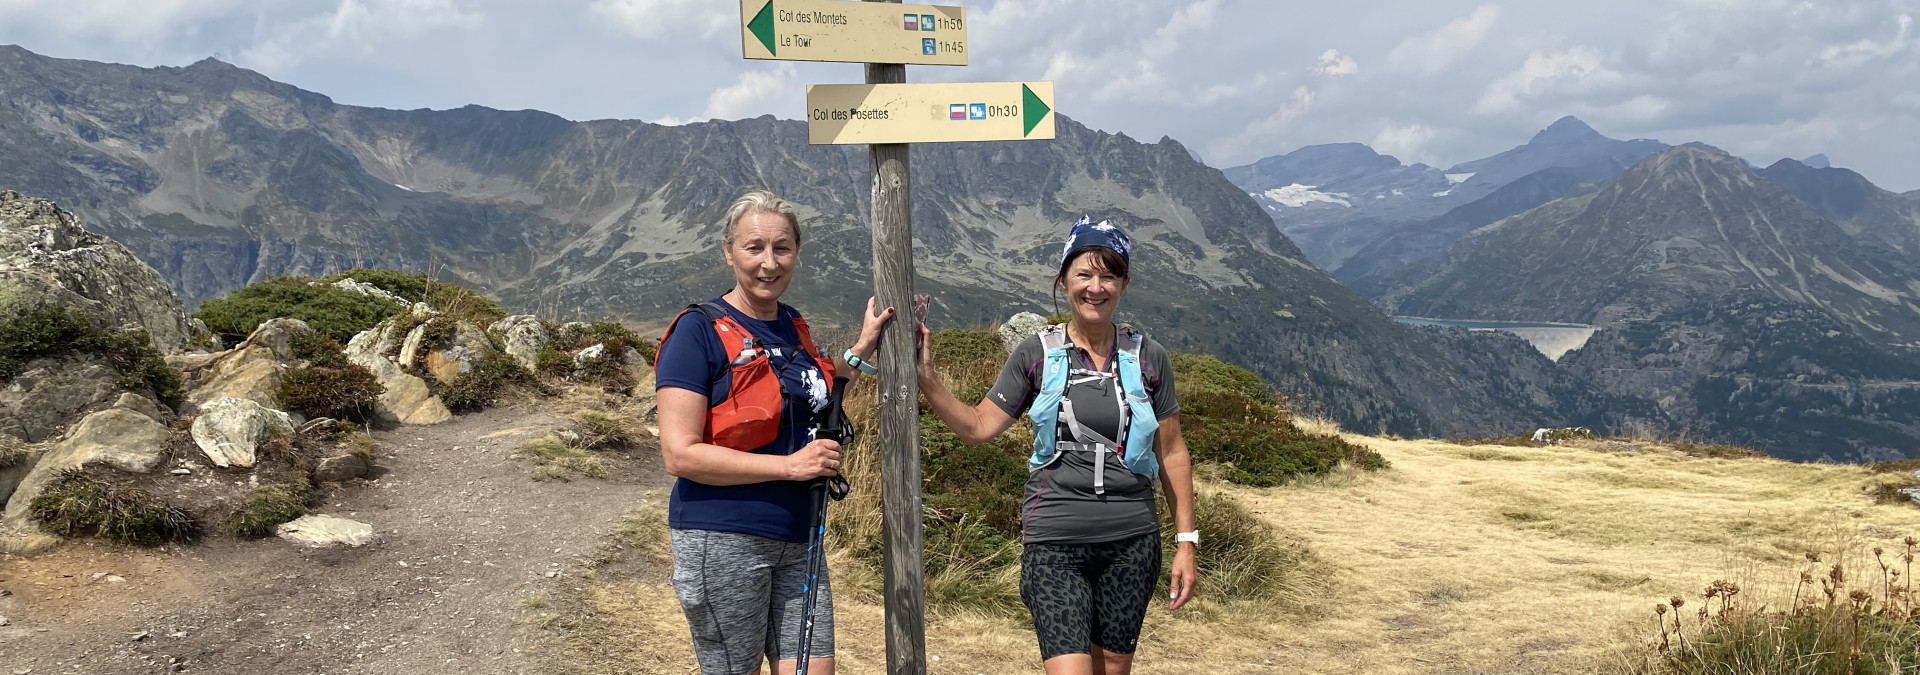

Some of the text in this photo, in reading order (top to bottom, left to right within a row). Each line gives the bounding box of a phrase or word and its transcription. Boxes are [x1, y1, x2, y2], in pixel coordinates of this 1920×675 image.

[779, 9, 962, 30] Col des Montets 1h50
[780, 34, 963, 53] Le Tour 1h45
[813, 105, 1017, 120] Col des Posettes 0h30
